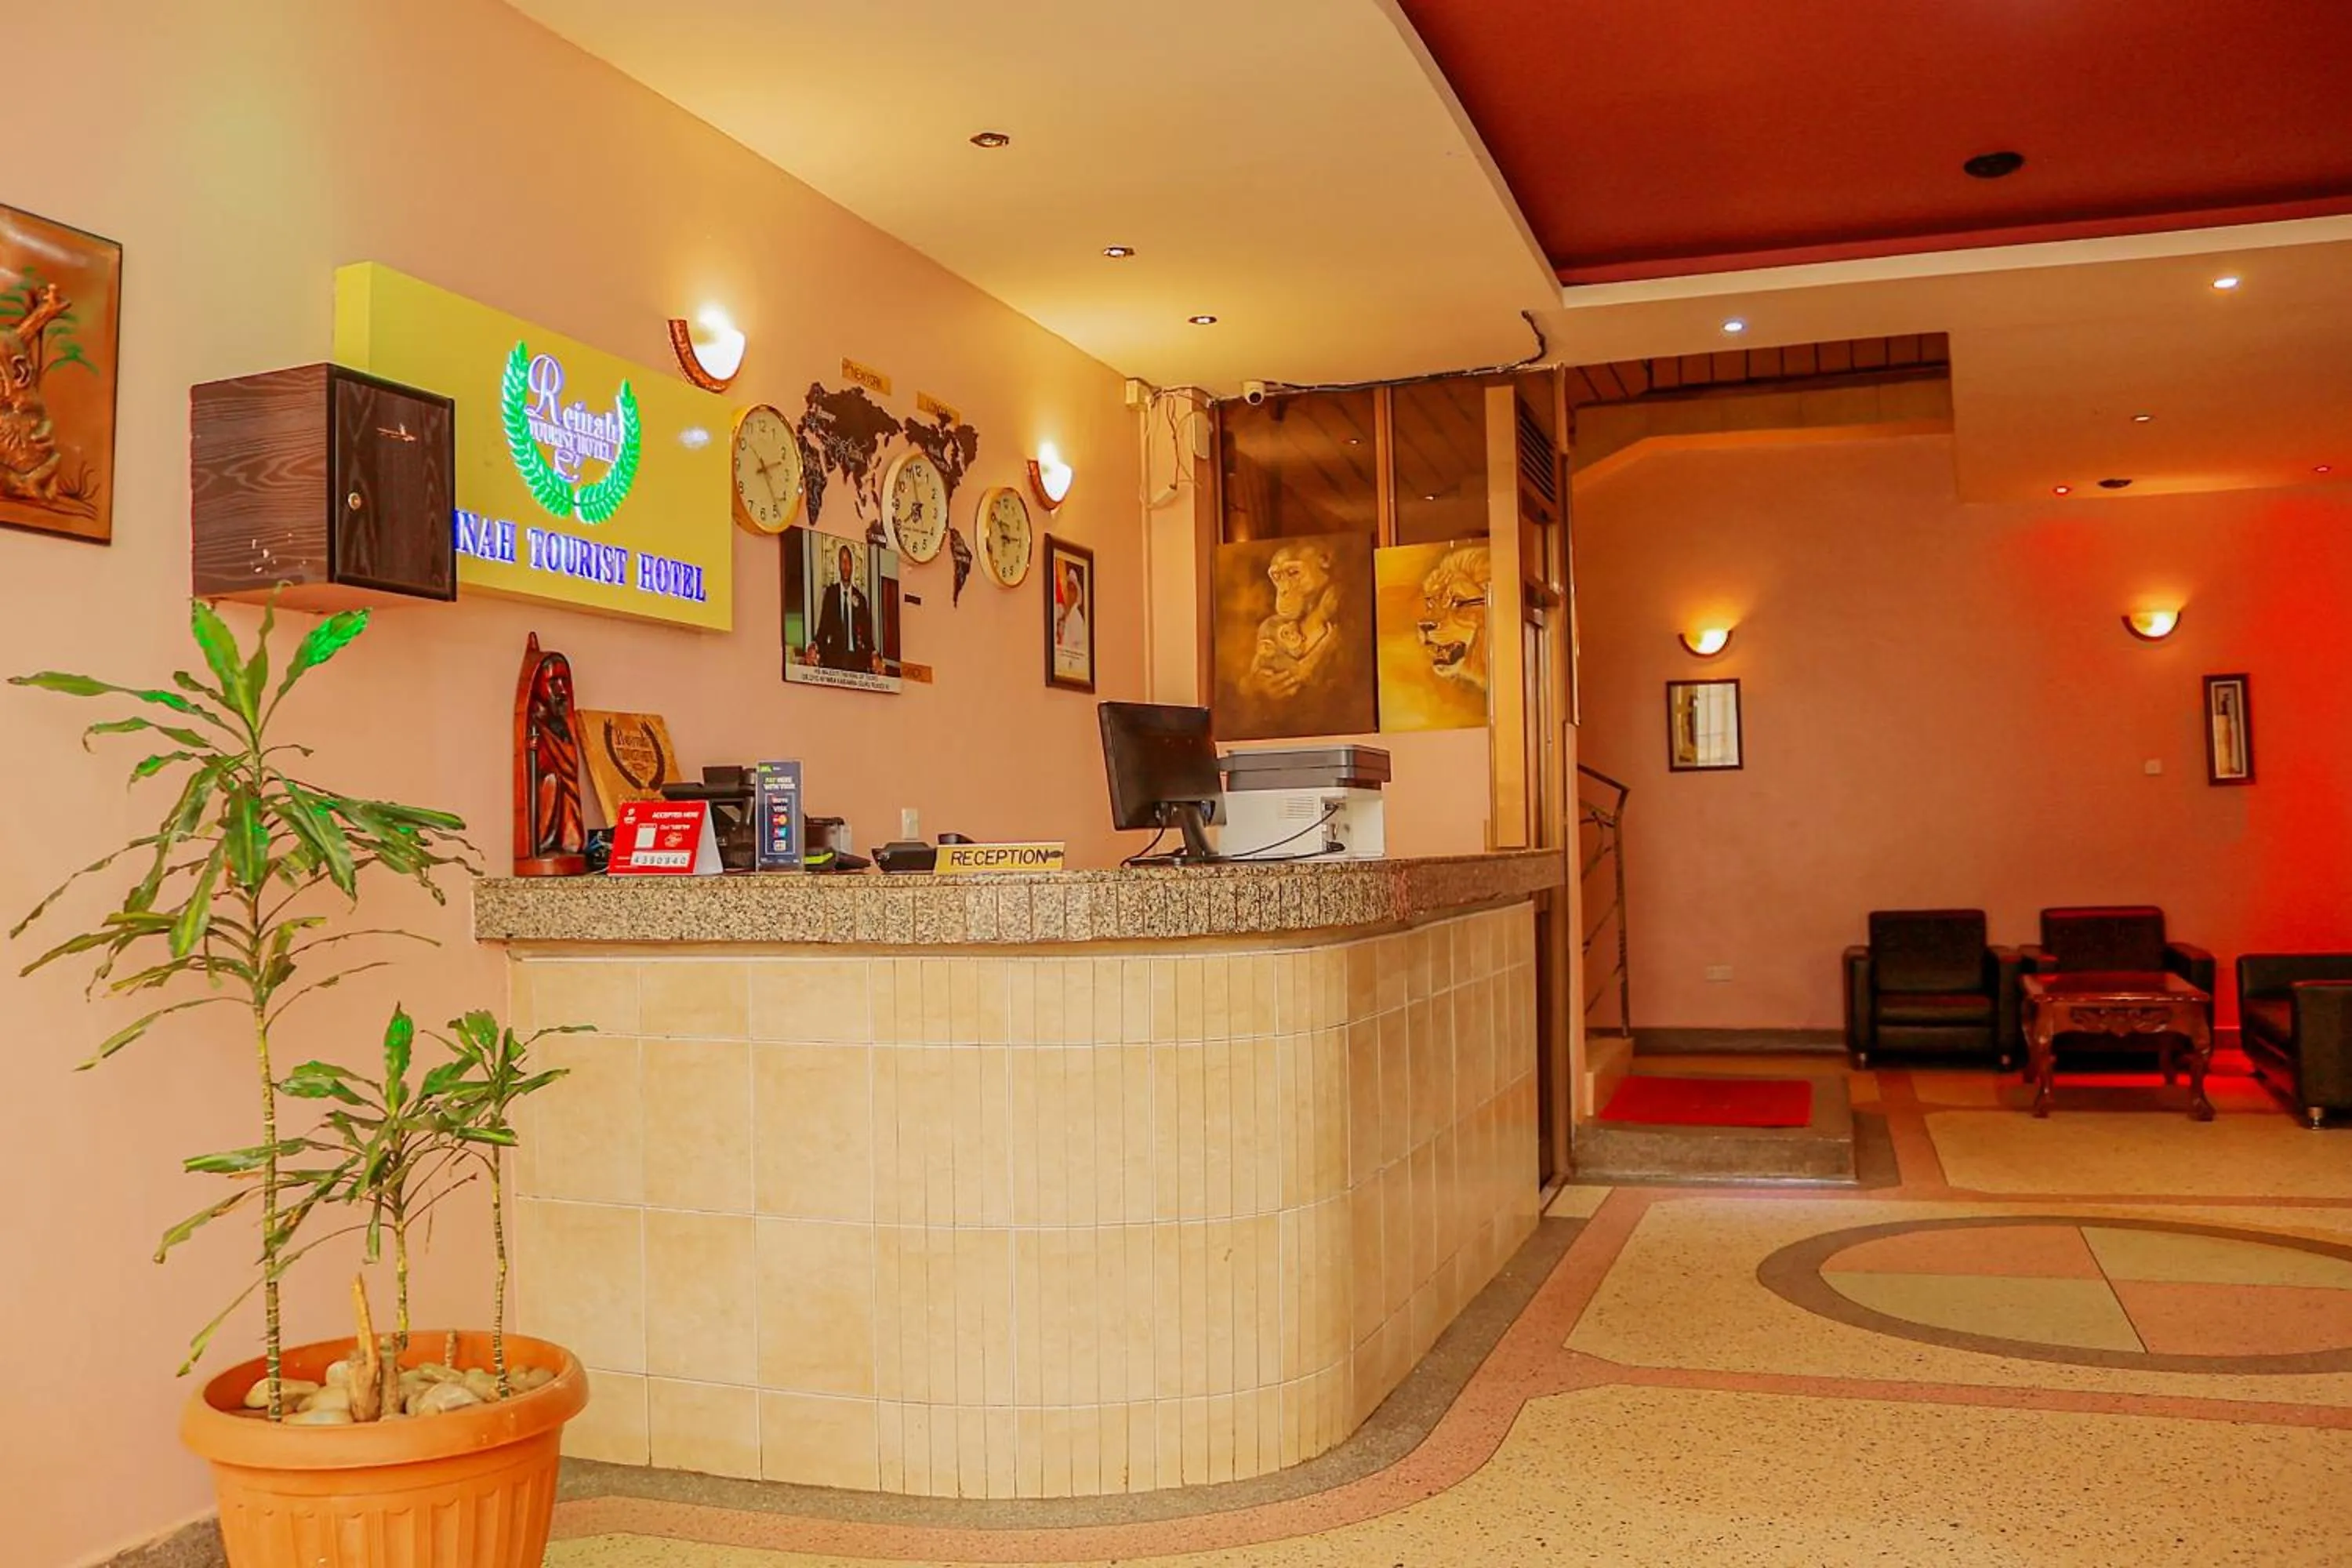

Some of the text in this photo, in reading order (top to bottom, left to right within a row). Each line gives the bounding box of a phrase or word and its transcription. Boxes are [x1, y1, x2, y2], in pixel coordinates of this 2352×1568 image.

[524, 354, 619, 444] Reinah
[747, 499, 753, 512] 7
[760, 507, 766, 521] 6
[527, 528, 628, 585] TOURIST
[636, 552, 707, 602] HOTEL
[950, 848, 1049, 866] RECEPTION
